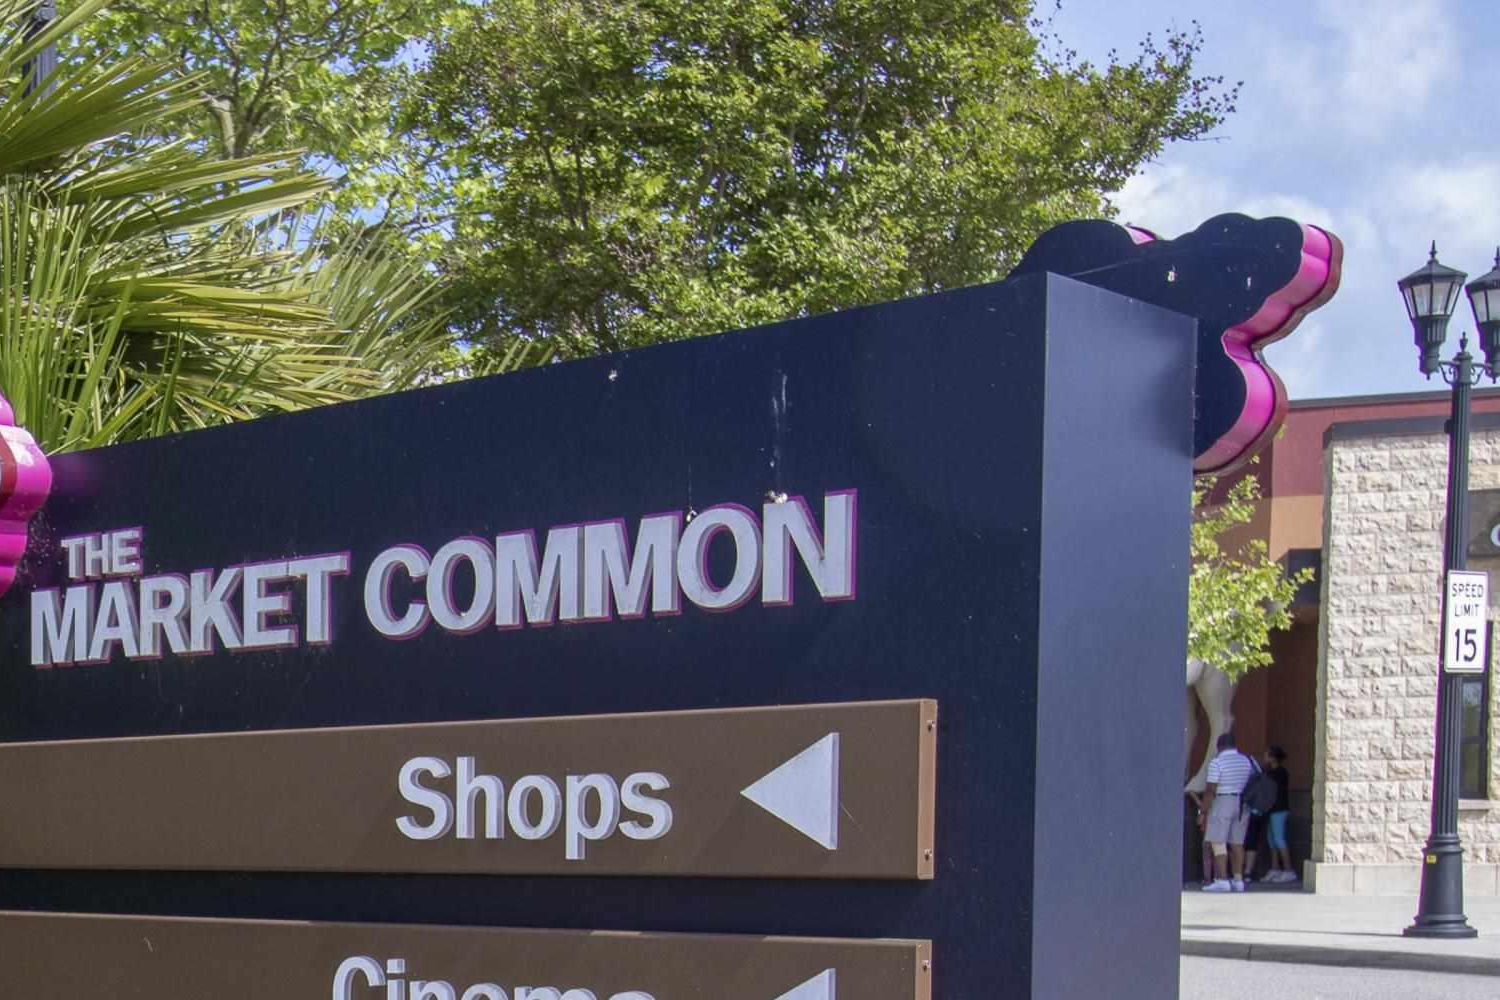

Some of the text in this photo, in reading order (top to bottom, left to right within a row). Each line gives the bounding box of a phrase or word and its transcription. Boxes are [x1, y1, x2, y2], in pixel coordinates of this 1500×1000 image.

[60, 527, 143, 581] THE
[31, 488, 857, 668] MARKET COMMON
[1452, 583, 1484, 598] SPEED
[1454, 603, 1480, 617] LIMIT
[1454, 628, 1477, 662] 15
[396, 756, 673, 860] Shops
